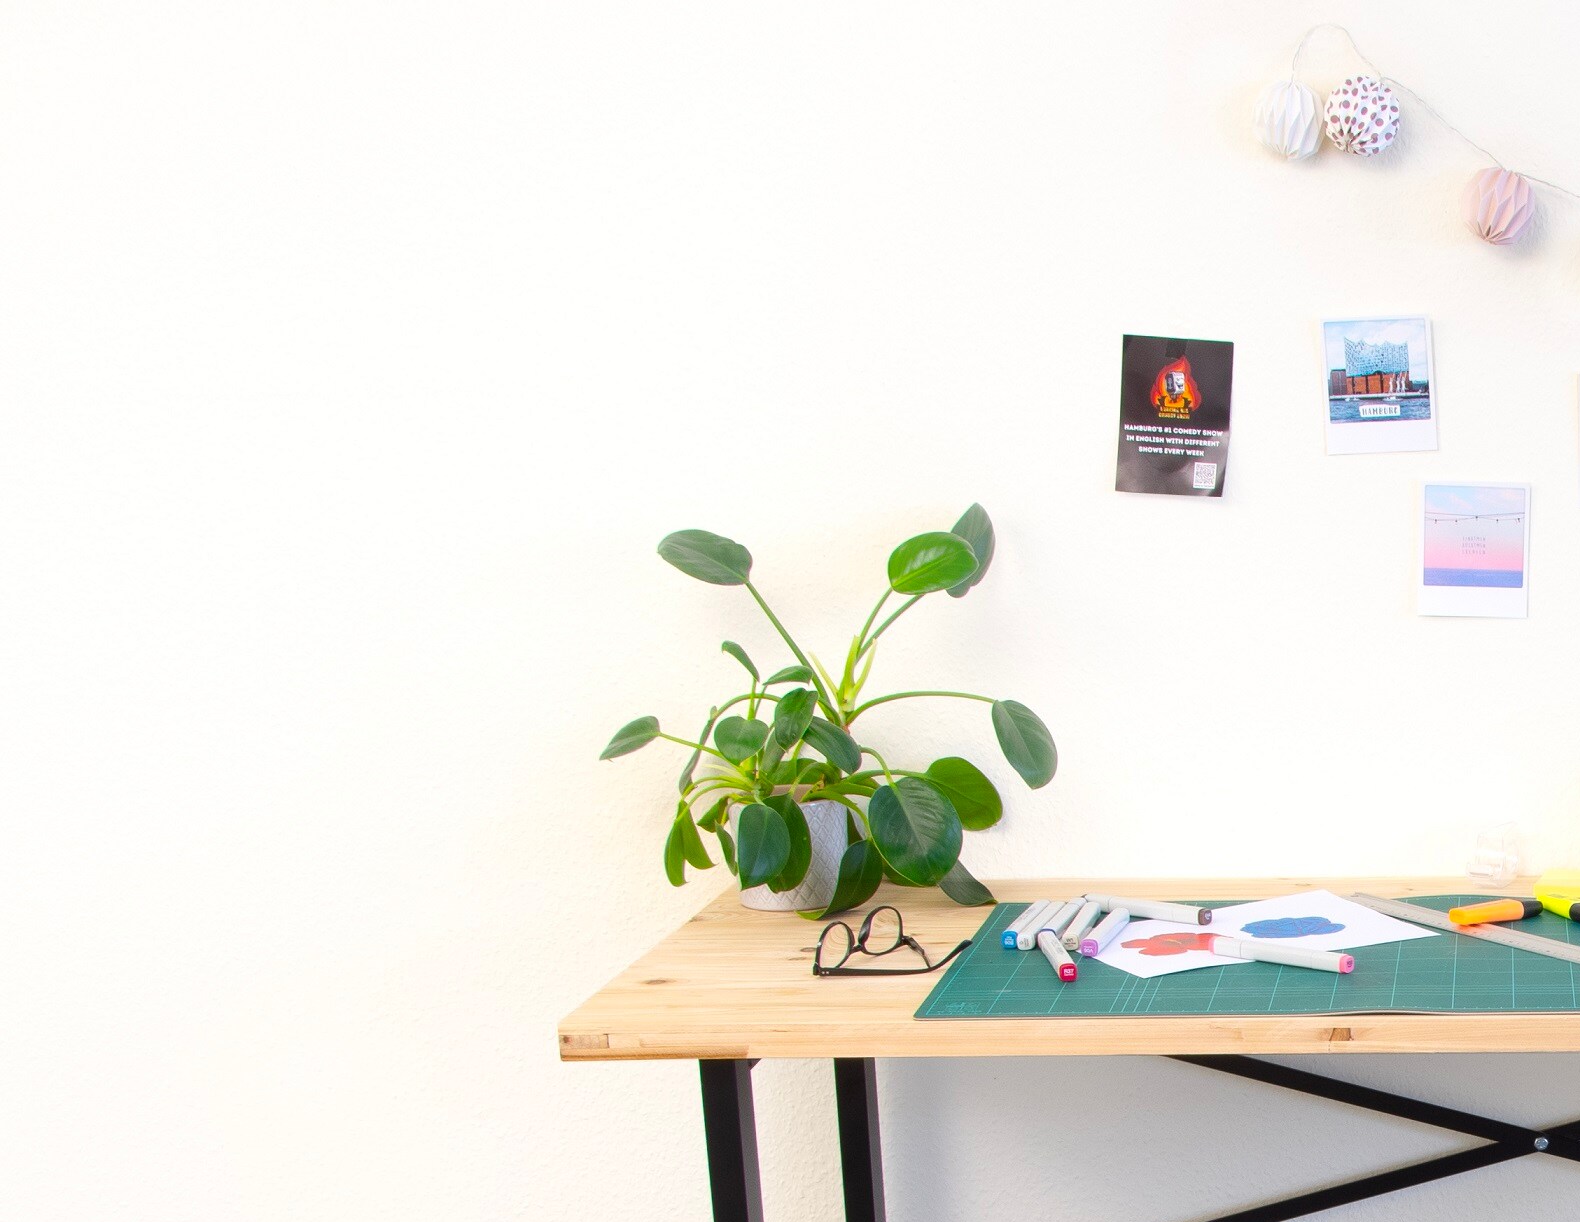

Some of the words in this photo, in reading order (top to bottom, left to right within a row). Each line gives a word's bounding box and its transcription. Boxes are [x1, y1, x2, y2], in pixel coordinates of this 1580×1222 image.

[1124, 424, 1163, 433] HAMBURG'S
[1173, 427, 1201, 435] COMEDY
[1202, 429, 1223, 437] SHOW
[1136, 435, 1164, 443] ENGLISH
[1165, 437, 1184, 445] WITH
[1184, 438, 1220, 447] DIFFERENT
[1138, 446, 1163, 454] SHOWS
